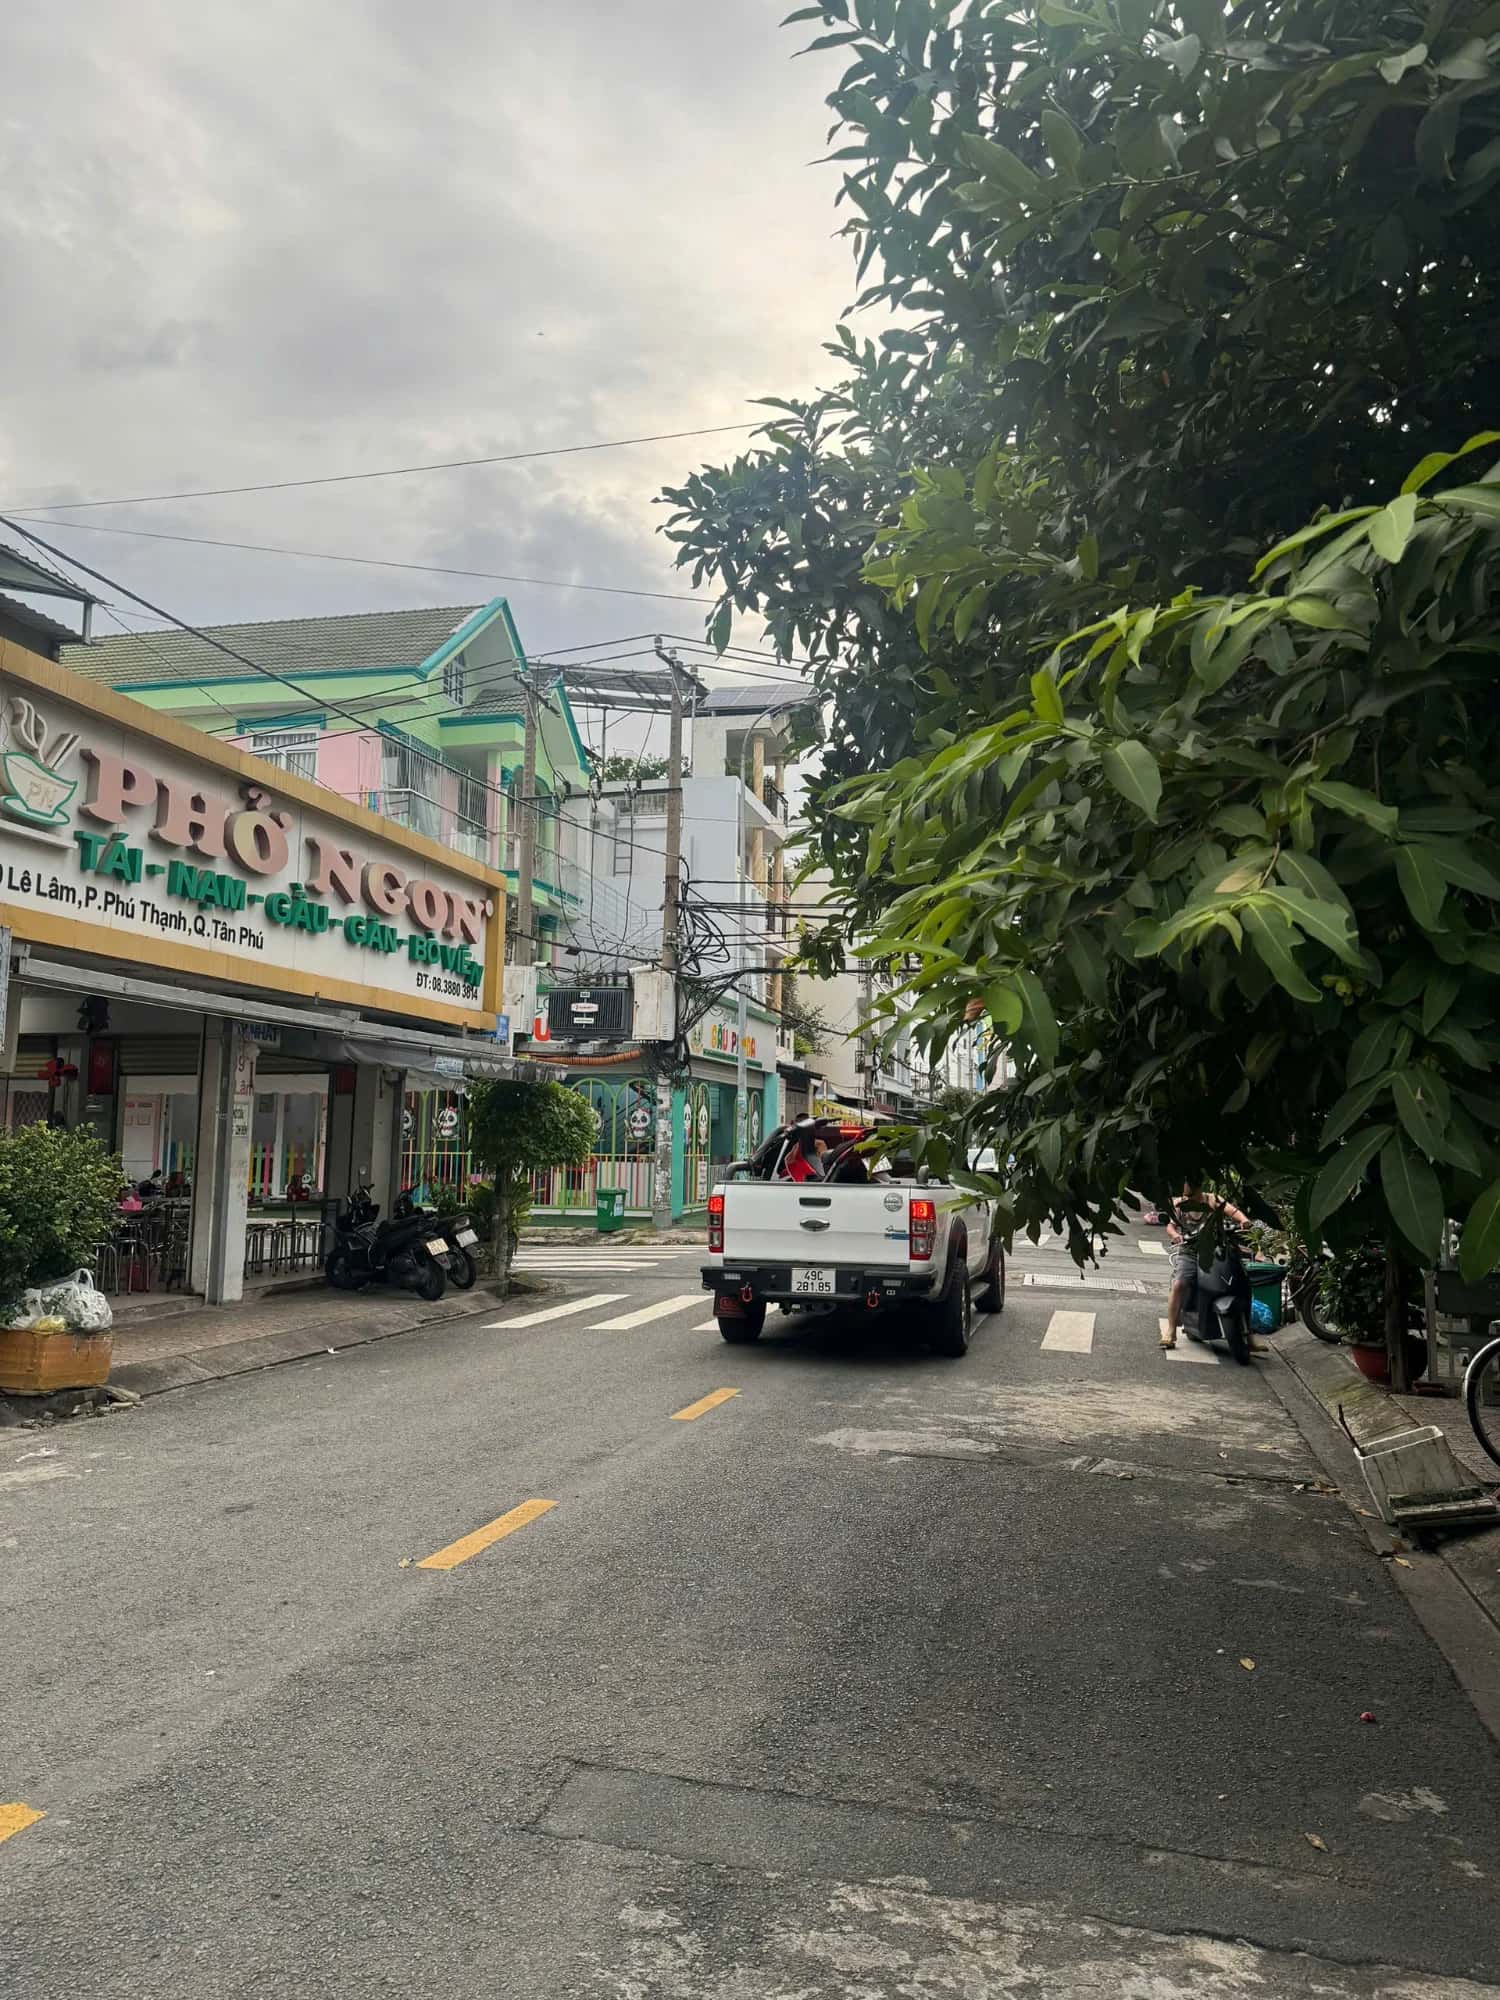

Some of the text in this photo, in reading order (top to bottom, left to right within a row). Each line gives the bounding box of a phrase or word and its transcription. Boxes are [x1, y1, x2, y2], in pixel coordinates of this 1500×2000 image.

[79, 749, 494, 944] PHỞ NGON
[8, 866, 32, 893] Lê
[239, 926, 264, 950] Phú
[796, 1281, 831, 1292] 281.85
[804, 1270, 824, 1281] 49C
